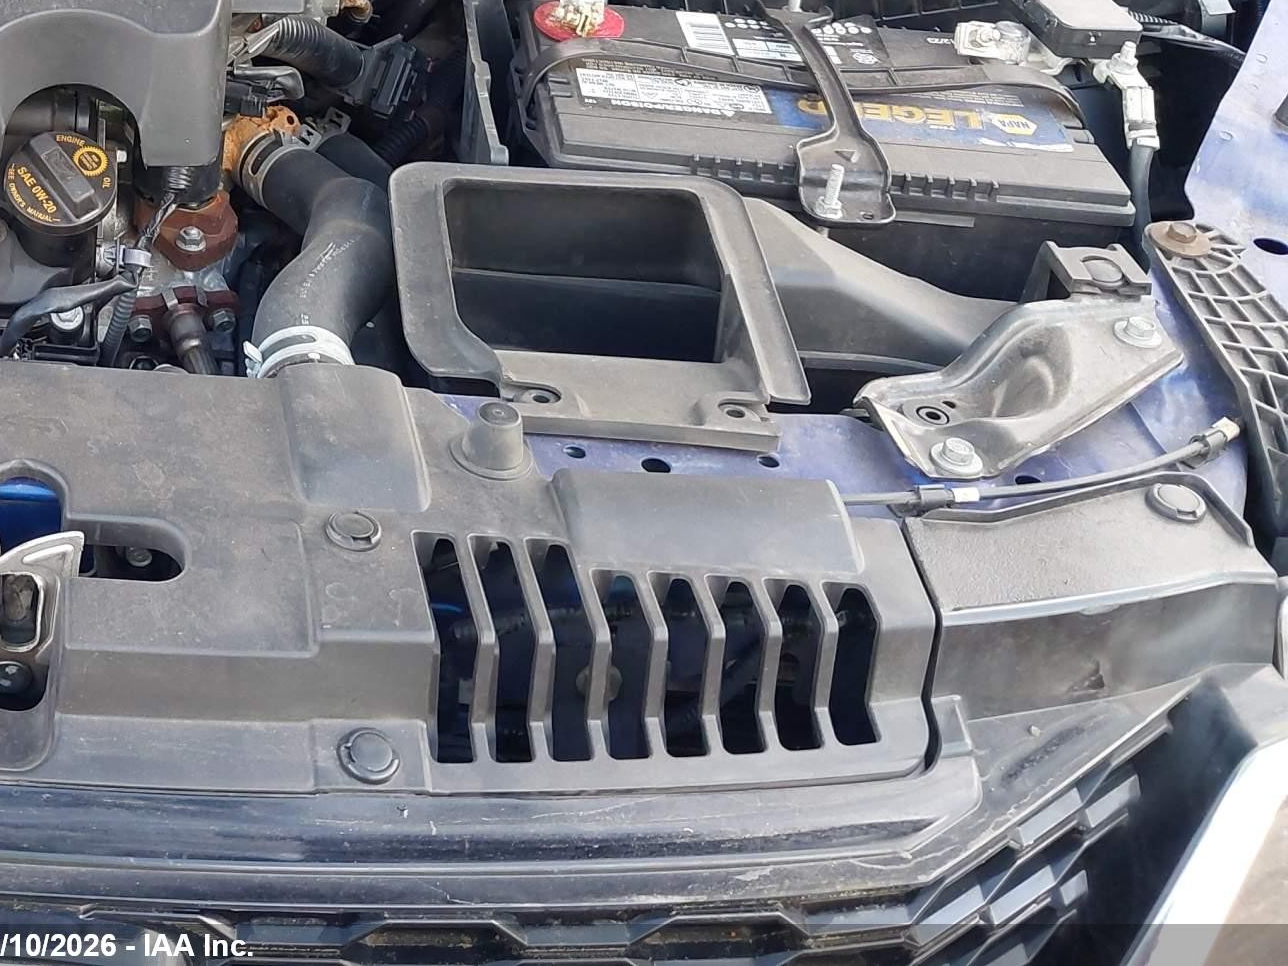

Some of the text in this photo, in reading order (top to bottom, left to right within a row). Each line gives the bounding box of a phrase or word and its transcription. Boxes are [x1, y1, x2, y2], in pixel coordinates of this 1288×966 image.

[796, 98, 985, 130] LEGED
[997, 118, 1030, 130] NAPA
[55, 134, 86, 147] ENGINE
[102, 176, 113, 189] OIL
[17, 166, 57, 213] SAE 0W-20
